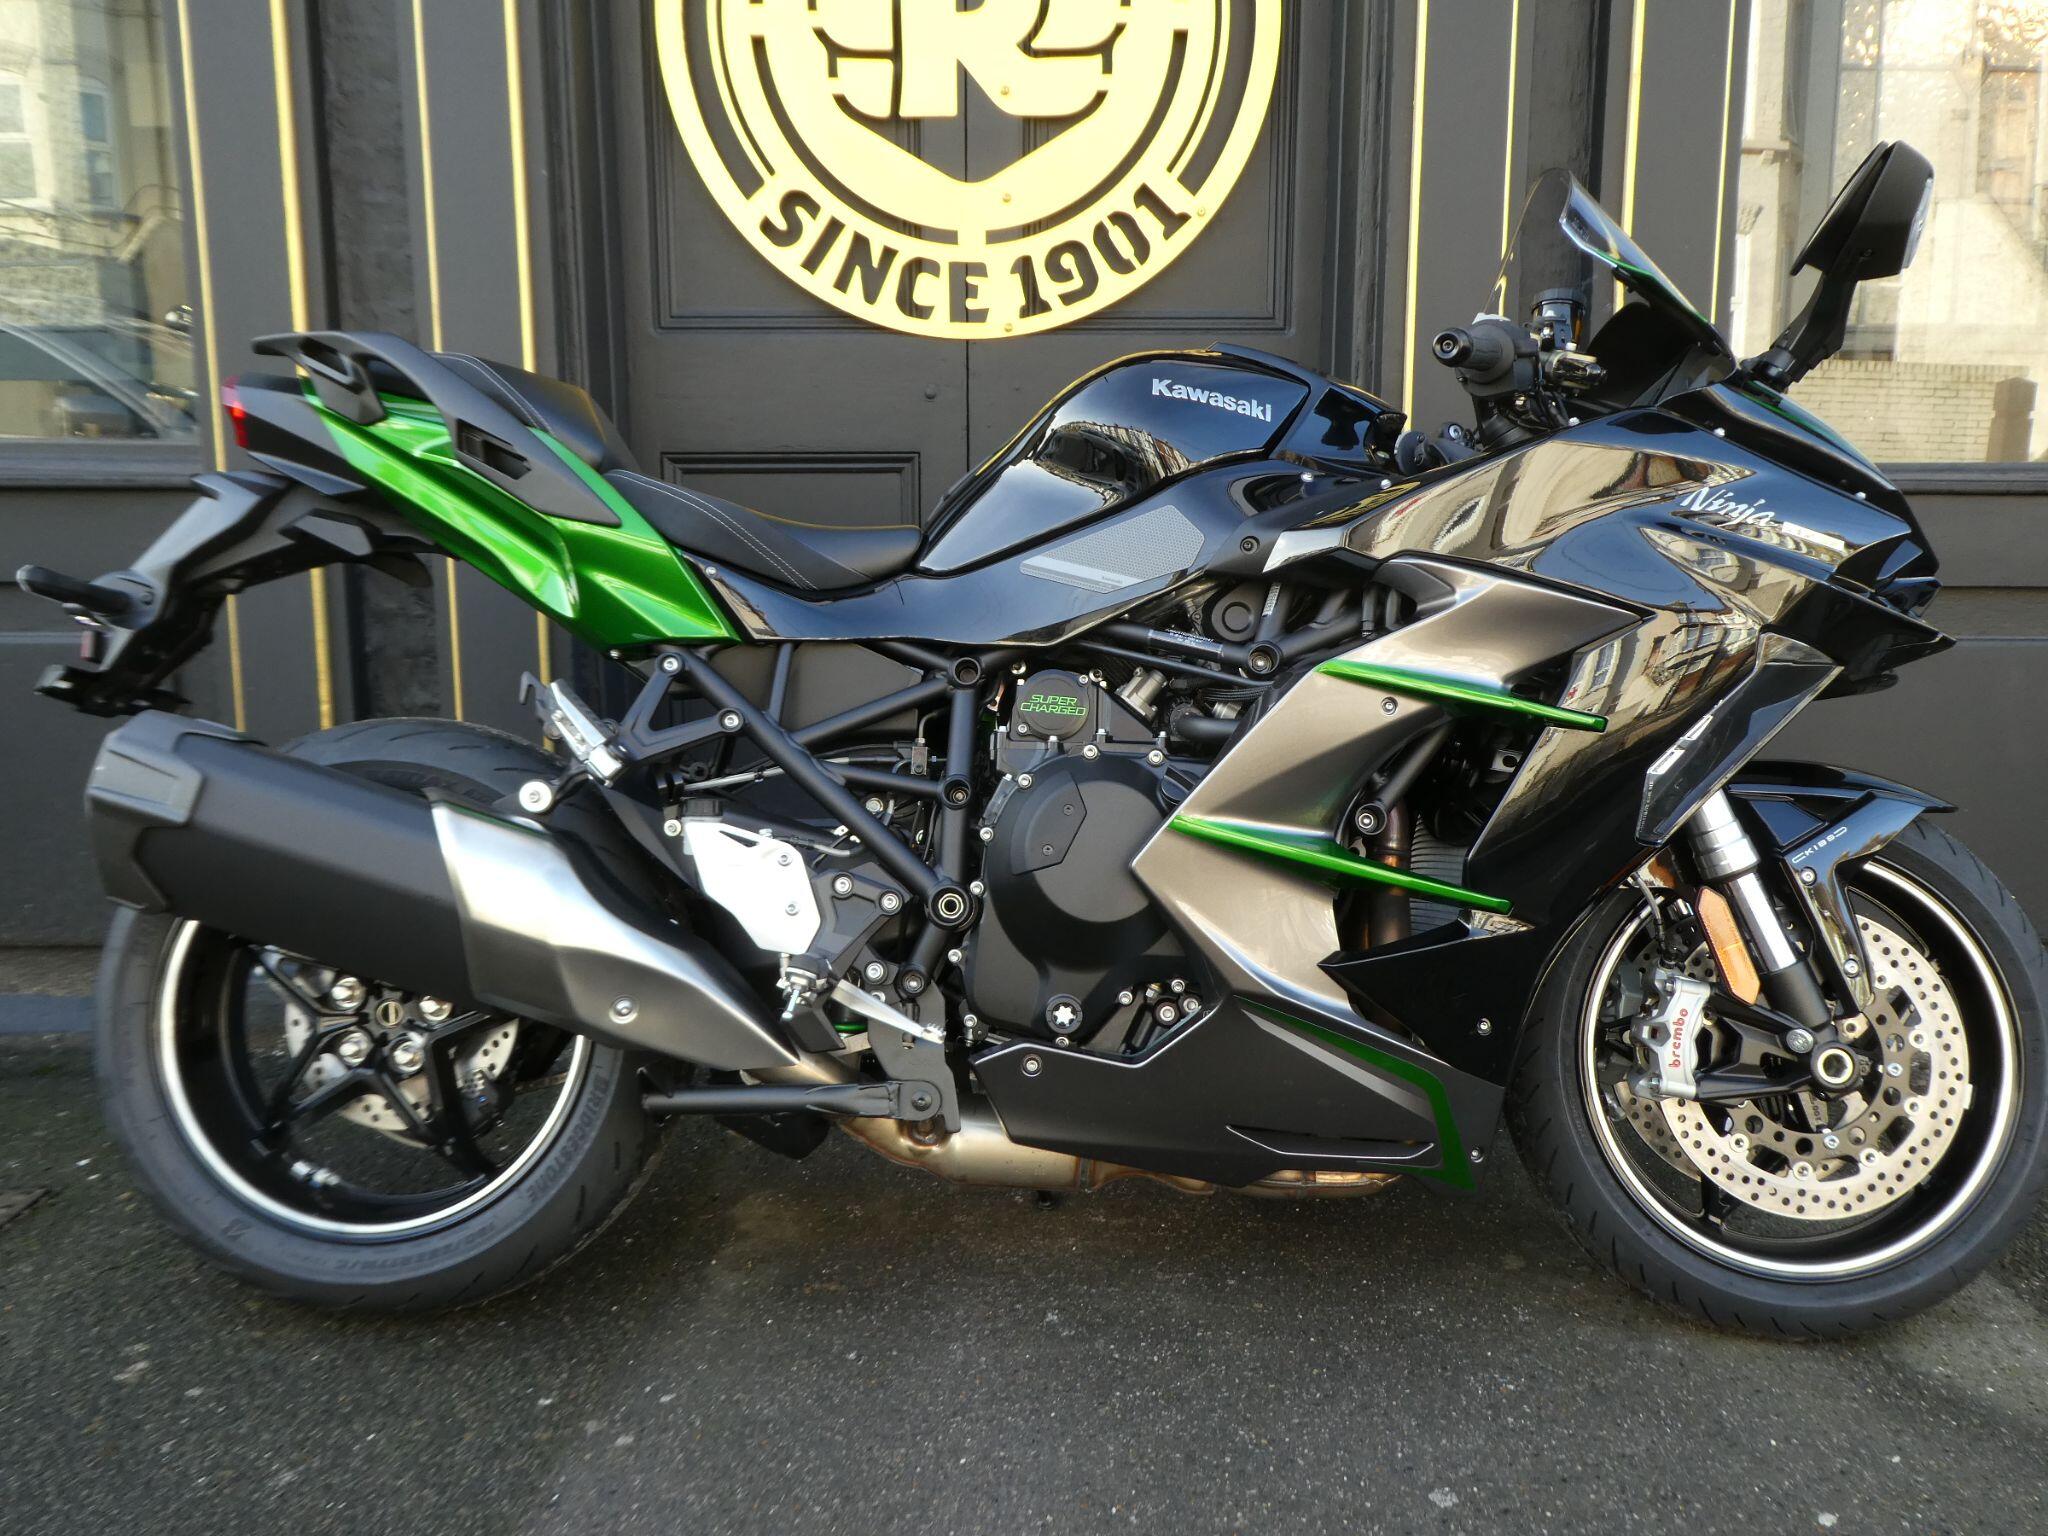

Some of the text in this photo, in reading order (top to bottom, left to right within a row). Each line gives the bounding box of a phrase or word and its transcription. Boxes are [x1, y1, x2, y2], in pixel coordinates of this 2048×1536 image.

[759, 182, 1192, 324] SINCE 1901
[1151, 378, 1272, 423] Kawasaki
[1680, 486, 1777, 527] Ninja
[1020, 702, 1086, 716] CHARGED
[1029, 694, 1078, 706] SUPER
[1668, 1008, 1689, 1068] brembo
